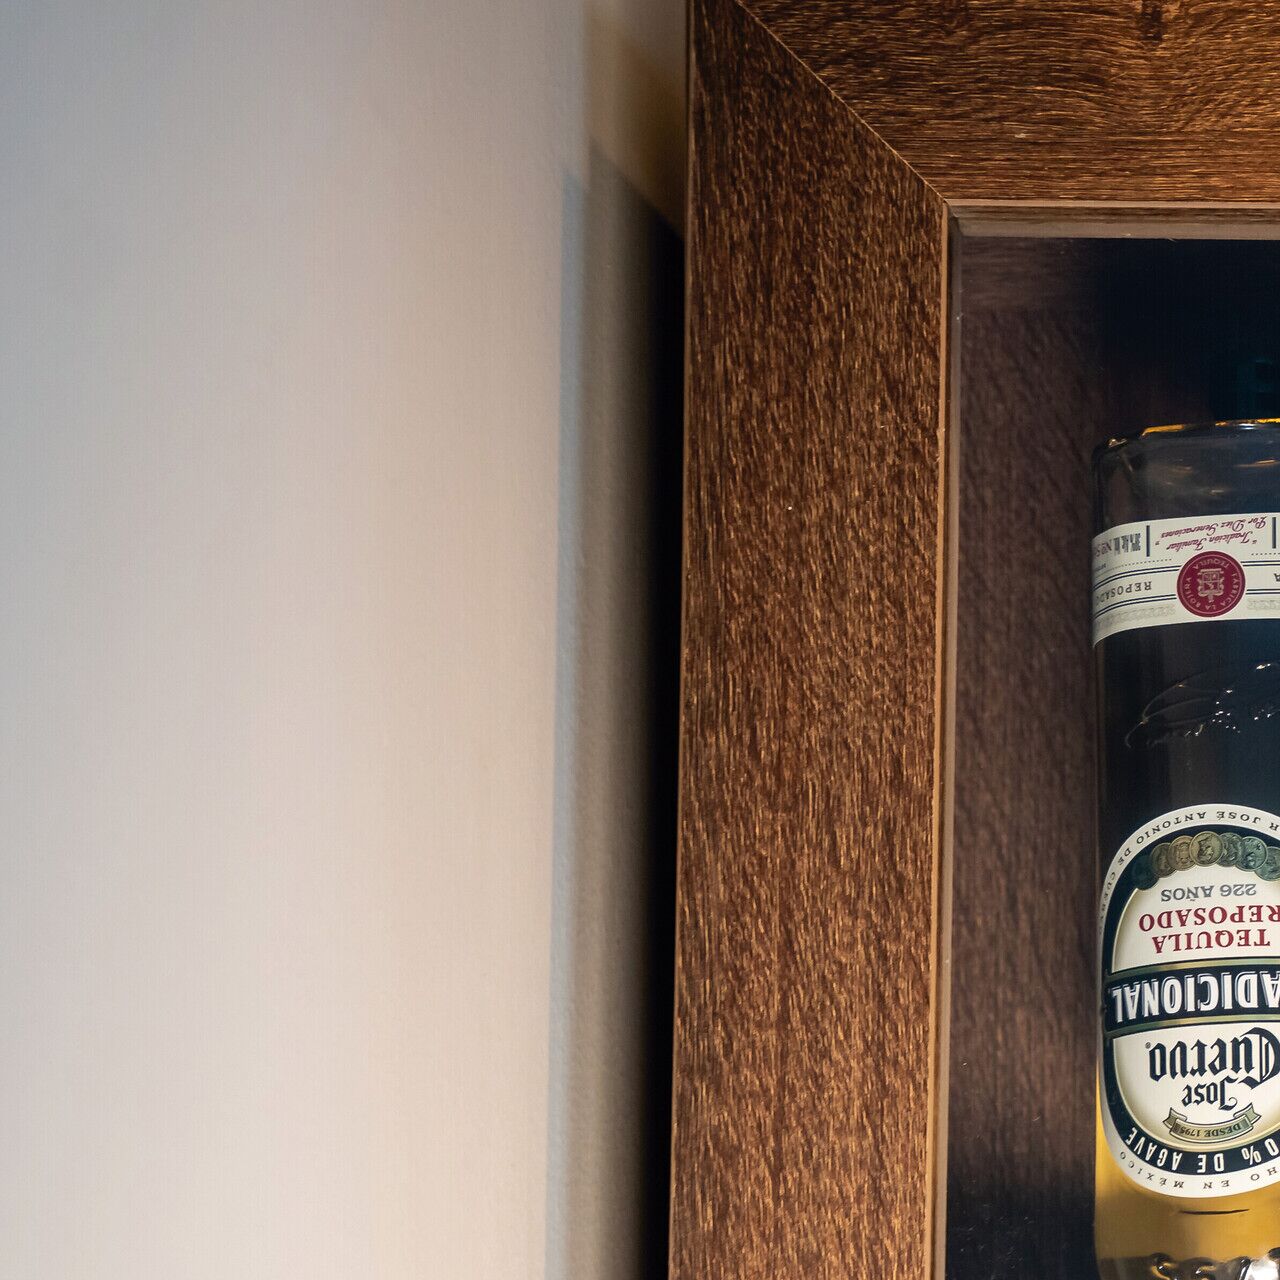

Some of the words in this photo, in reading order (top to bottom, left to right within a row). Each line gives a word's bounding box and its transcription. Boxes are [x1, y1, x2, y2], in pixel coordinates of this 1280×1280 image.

[1221, 519, 1246, 532] Diez
[1248, 516, 1267, 529] Por
[1166, 537, 1207, 552] Familiar
[1216, 810, 1261, 825] JOSÉ
[1135, 810, 1207, 845] ANTONIO
[1117, 847, 1132, 867] DE
[1160, 884, 1215, 903] AÑOS
[1220, 883, 1257, 897] 226
[1151, 928, 1271, 954] TEQUILA
[1180, 1076, 1238, 1111] Jose
[1179, 1126, 1201, 1138] 1795
[1203, 1123, 1240, 1138] DESDE
[1124, 1125, 1183, 1171] AGAVE
[1119, 1150, 1185, 1190] MÉXICO
[1197, 1152, 1224, 1174] DE
[1202, 1179, 1230, 1190] EN
